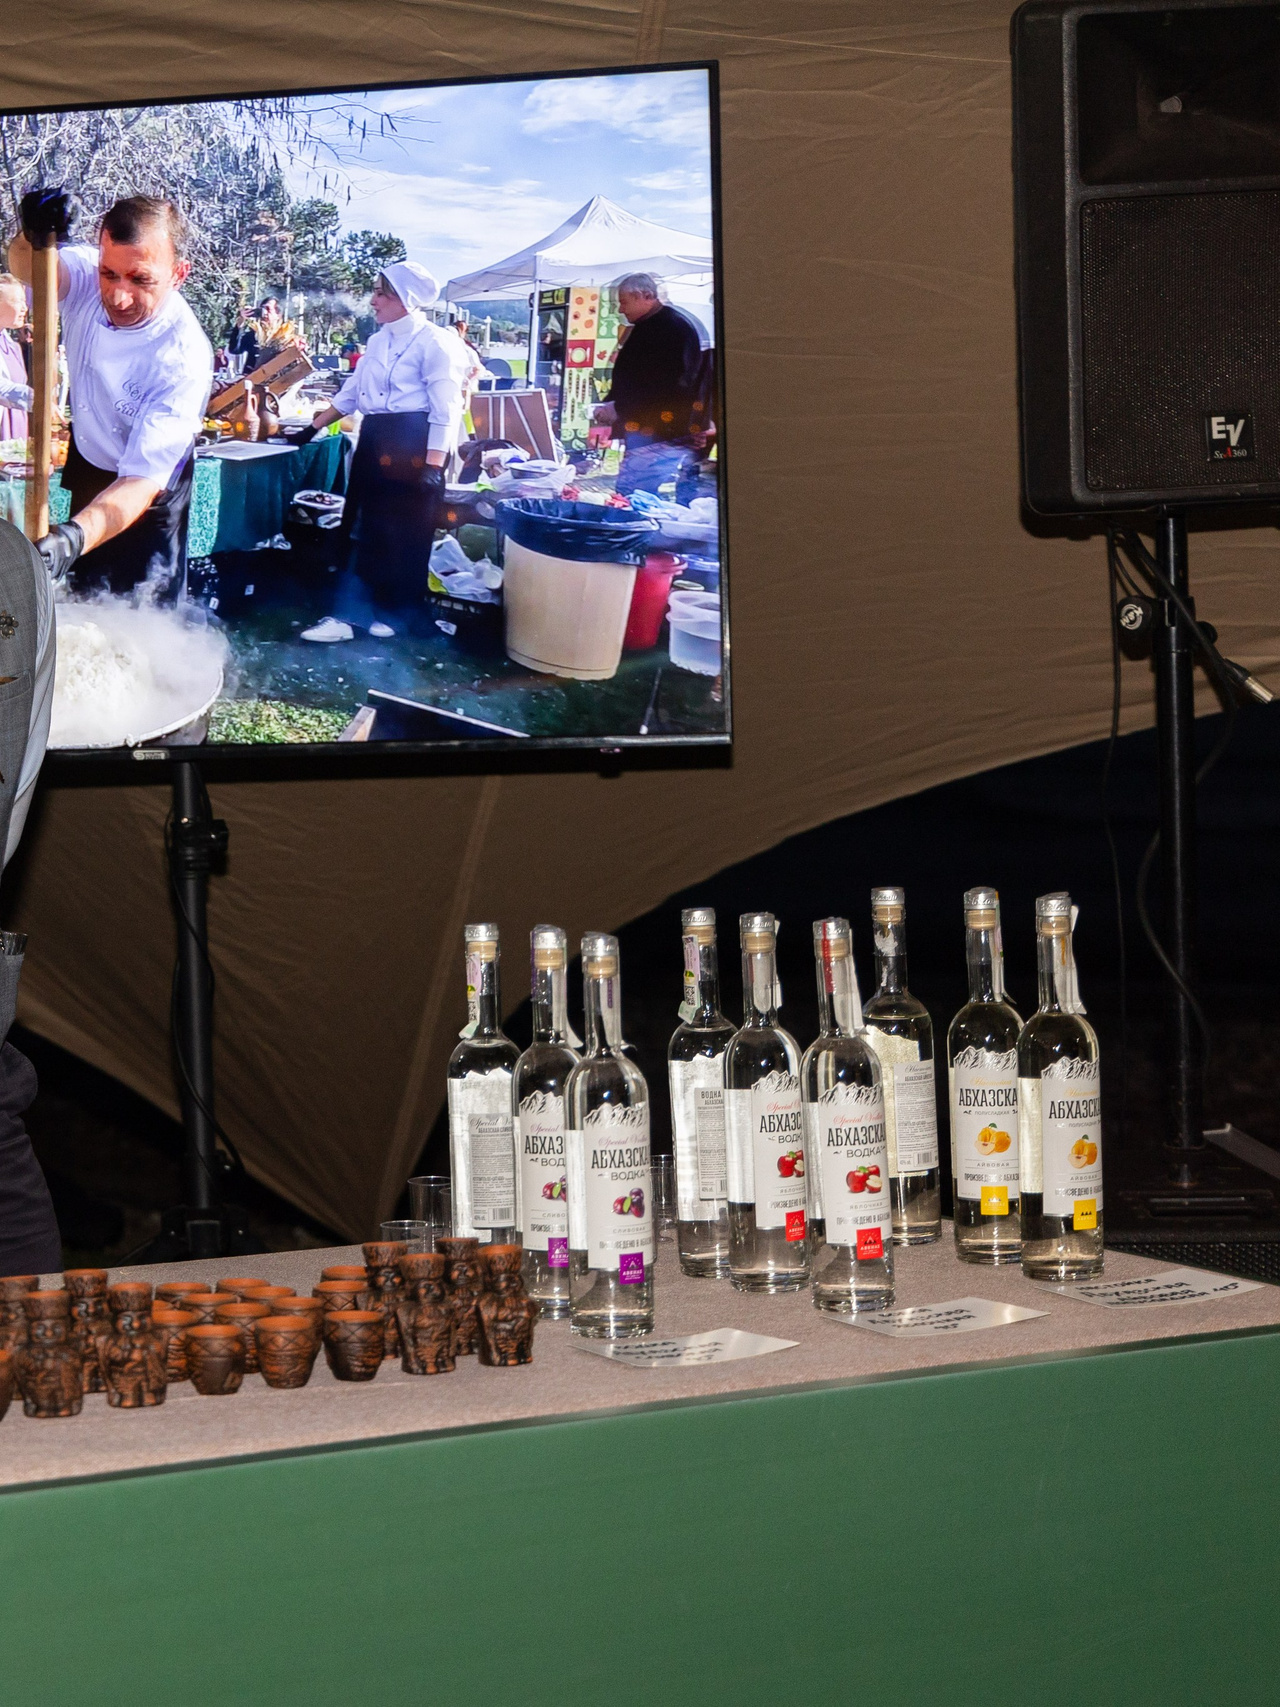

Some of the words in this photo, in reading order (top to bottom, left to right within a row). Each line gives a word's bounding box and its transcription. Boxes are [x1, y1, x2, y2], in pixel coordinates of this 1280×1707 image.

[1211, 416, 1245, 446] EV
[524, 1135, 564, 1155] АБХАЗ
[846, 1146, 882, 1159] ВОДКА
[611, 1170, 645, 1181] ВОДКА
